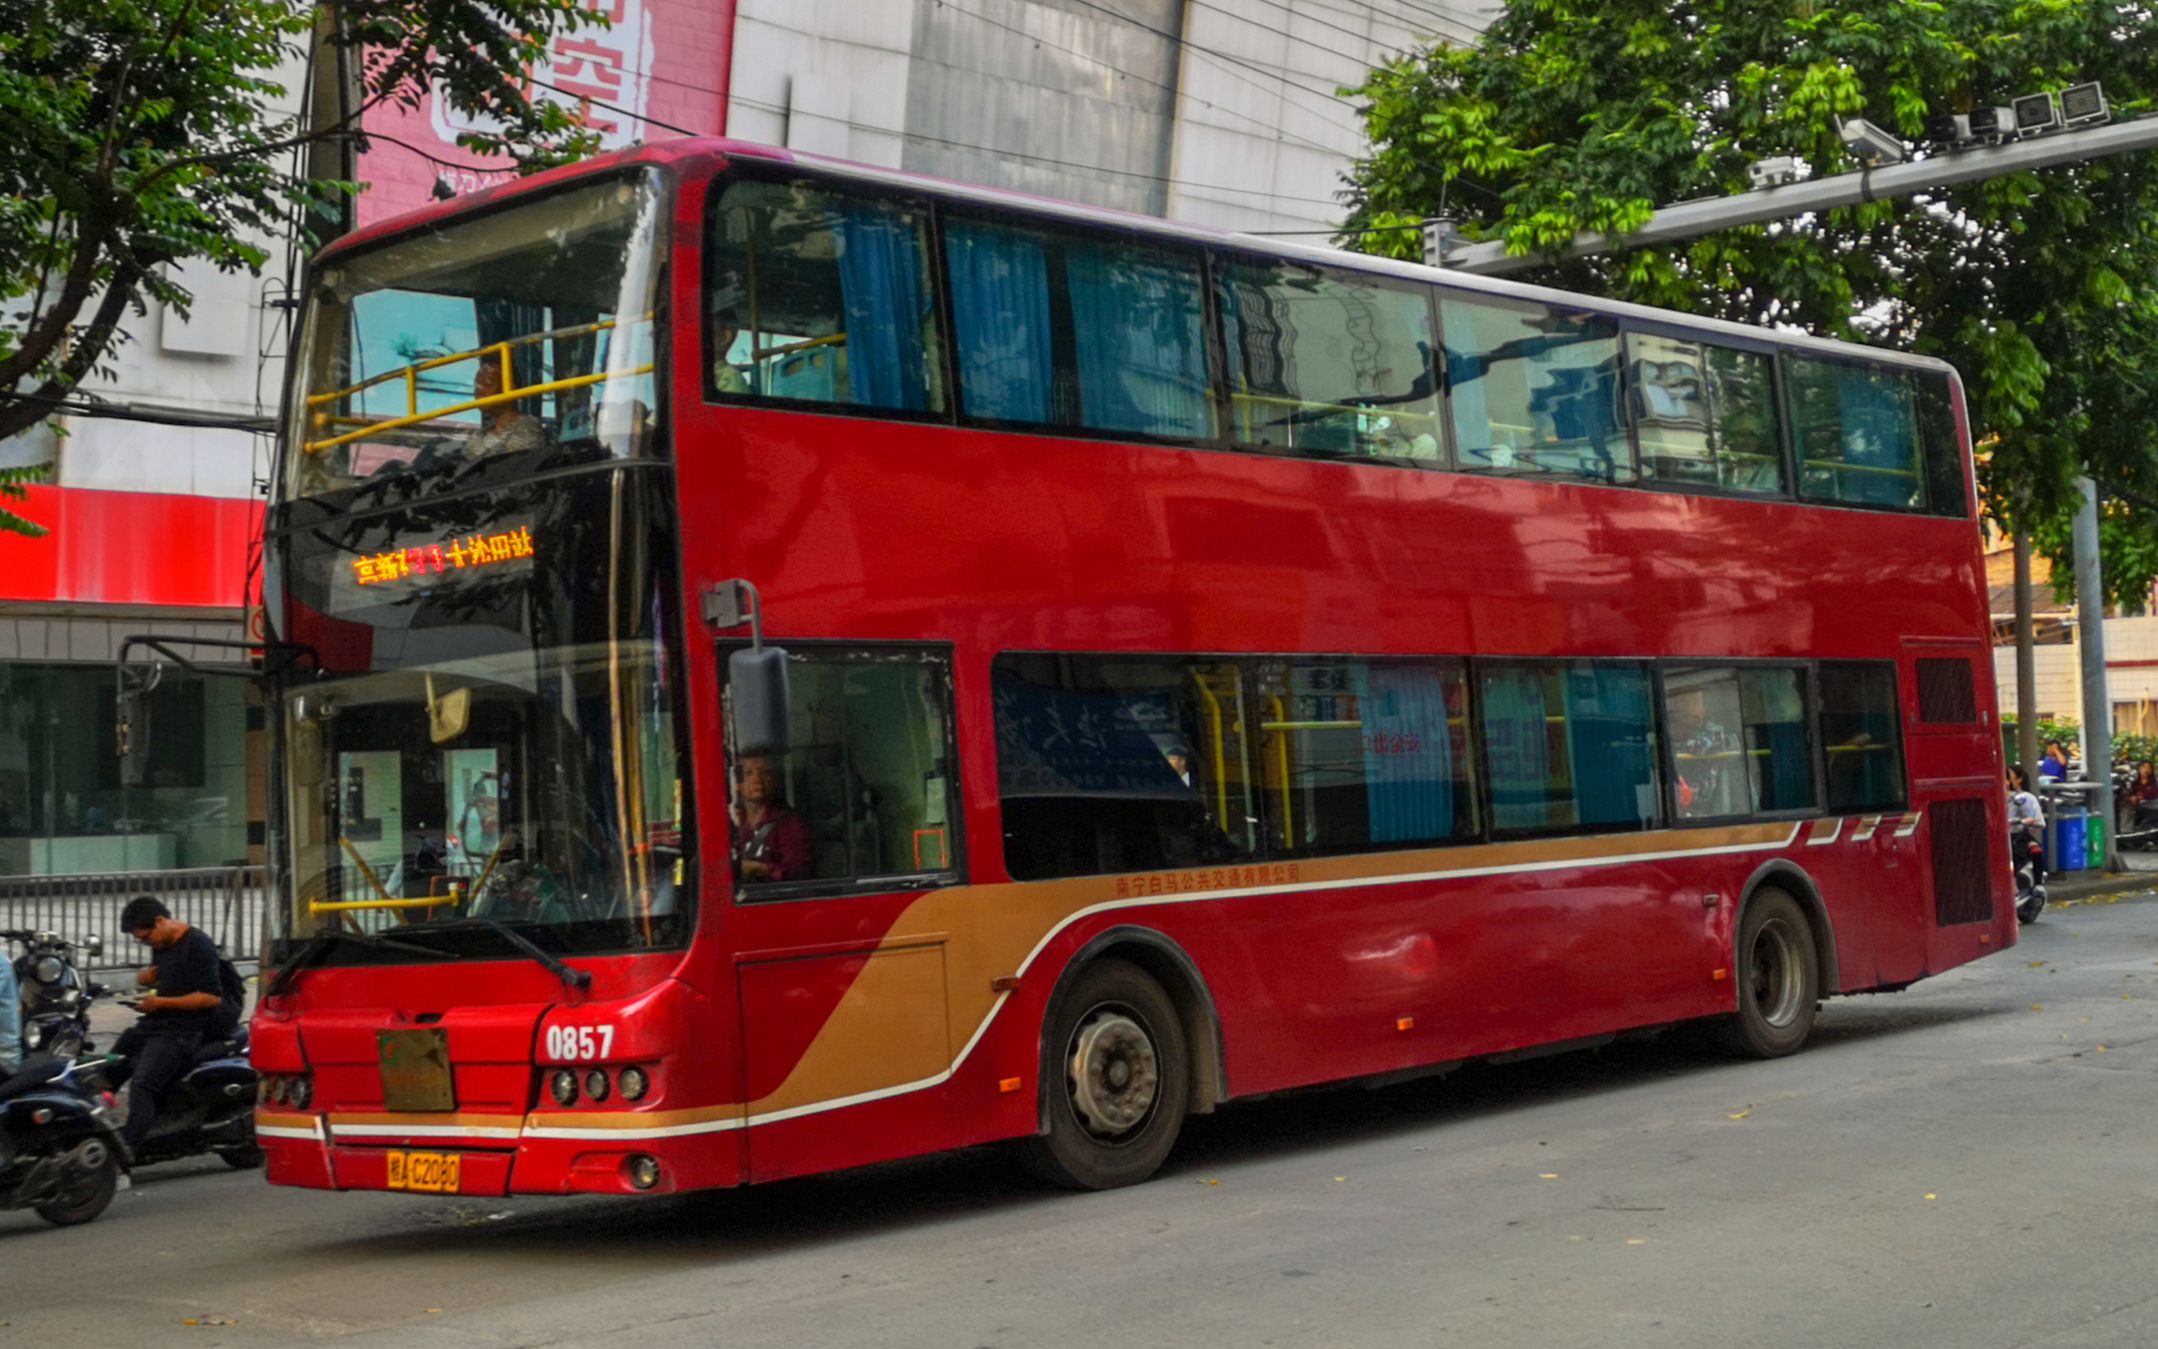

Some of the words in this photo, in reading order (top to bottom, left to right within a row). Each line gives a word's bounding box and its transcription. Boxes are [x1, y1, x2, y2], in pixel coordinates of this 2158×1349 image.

[1116, 863, 1300, 898] 南宁白马公共交通有限公司
[546, 1024, 614, 1060] 0857
